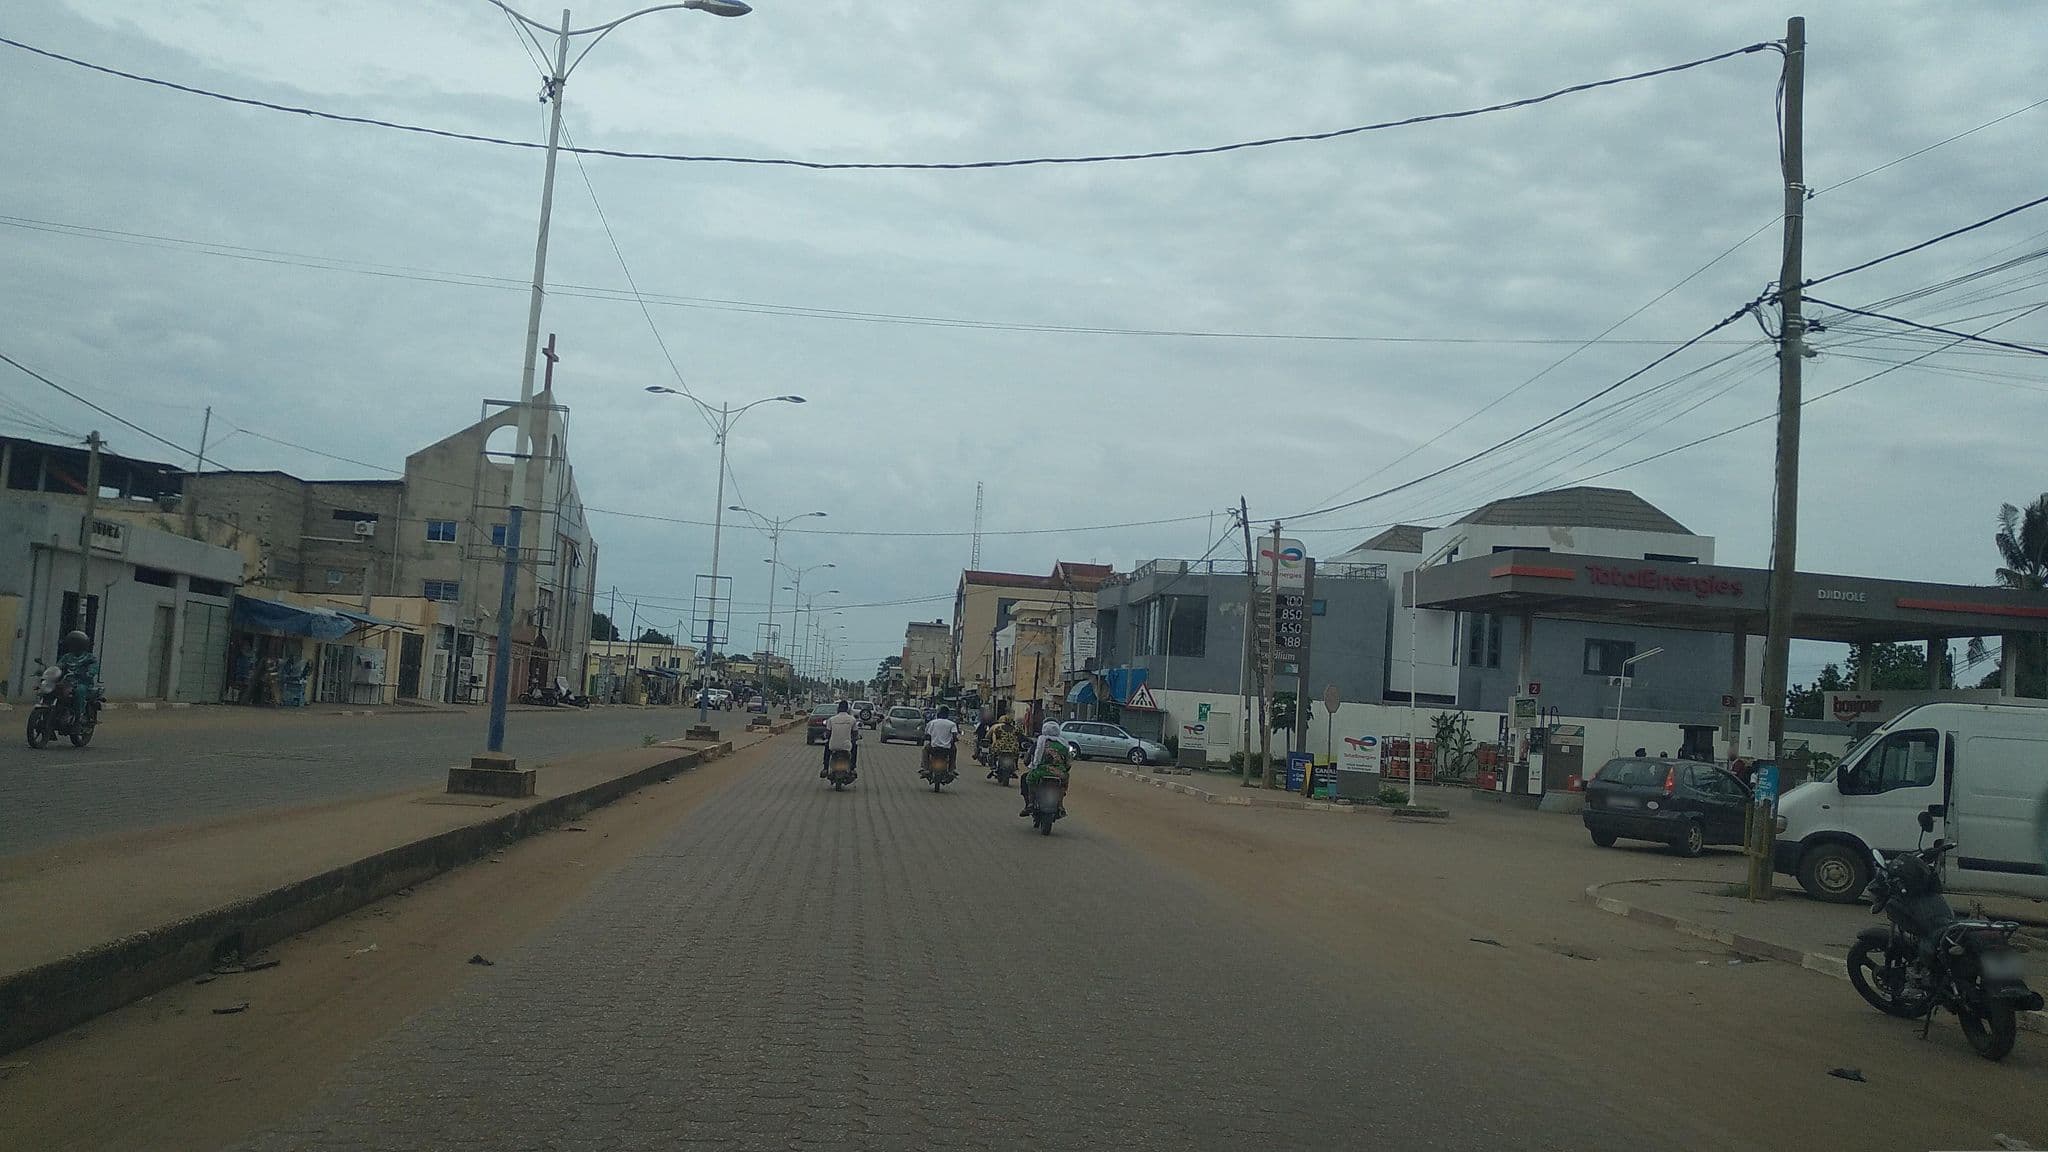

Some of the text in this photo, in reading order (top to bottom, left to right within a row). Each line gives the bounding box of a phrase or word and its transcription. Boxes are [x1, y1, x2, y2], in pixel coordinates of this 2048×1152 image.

[1260, 569, 1302, 580] Totanergies
[1584, 563, 1744, 599] TotalEnergies
[1817, 588, 1867, 602] DJIDJOLE
